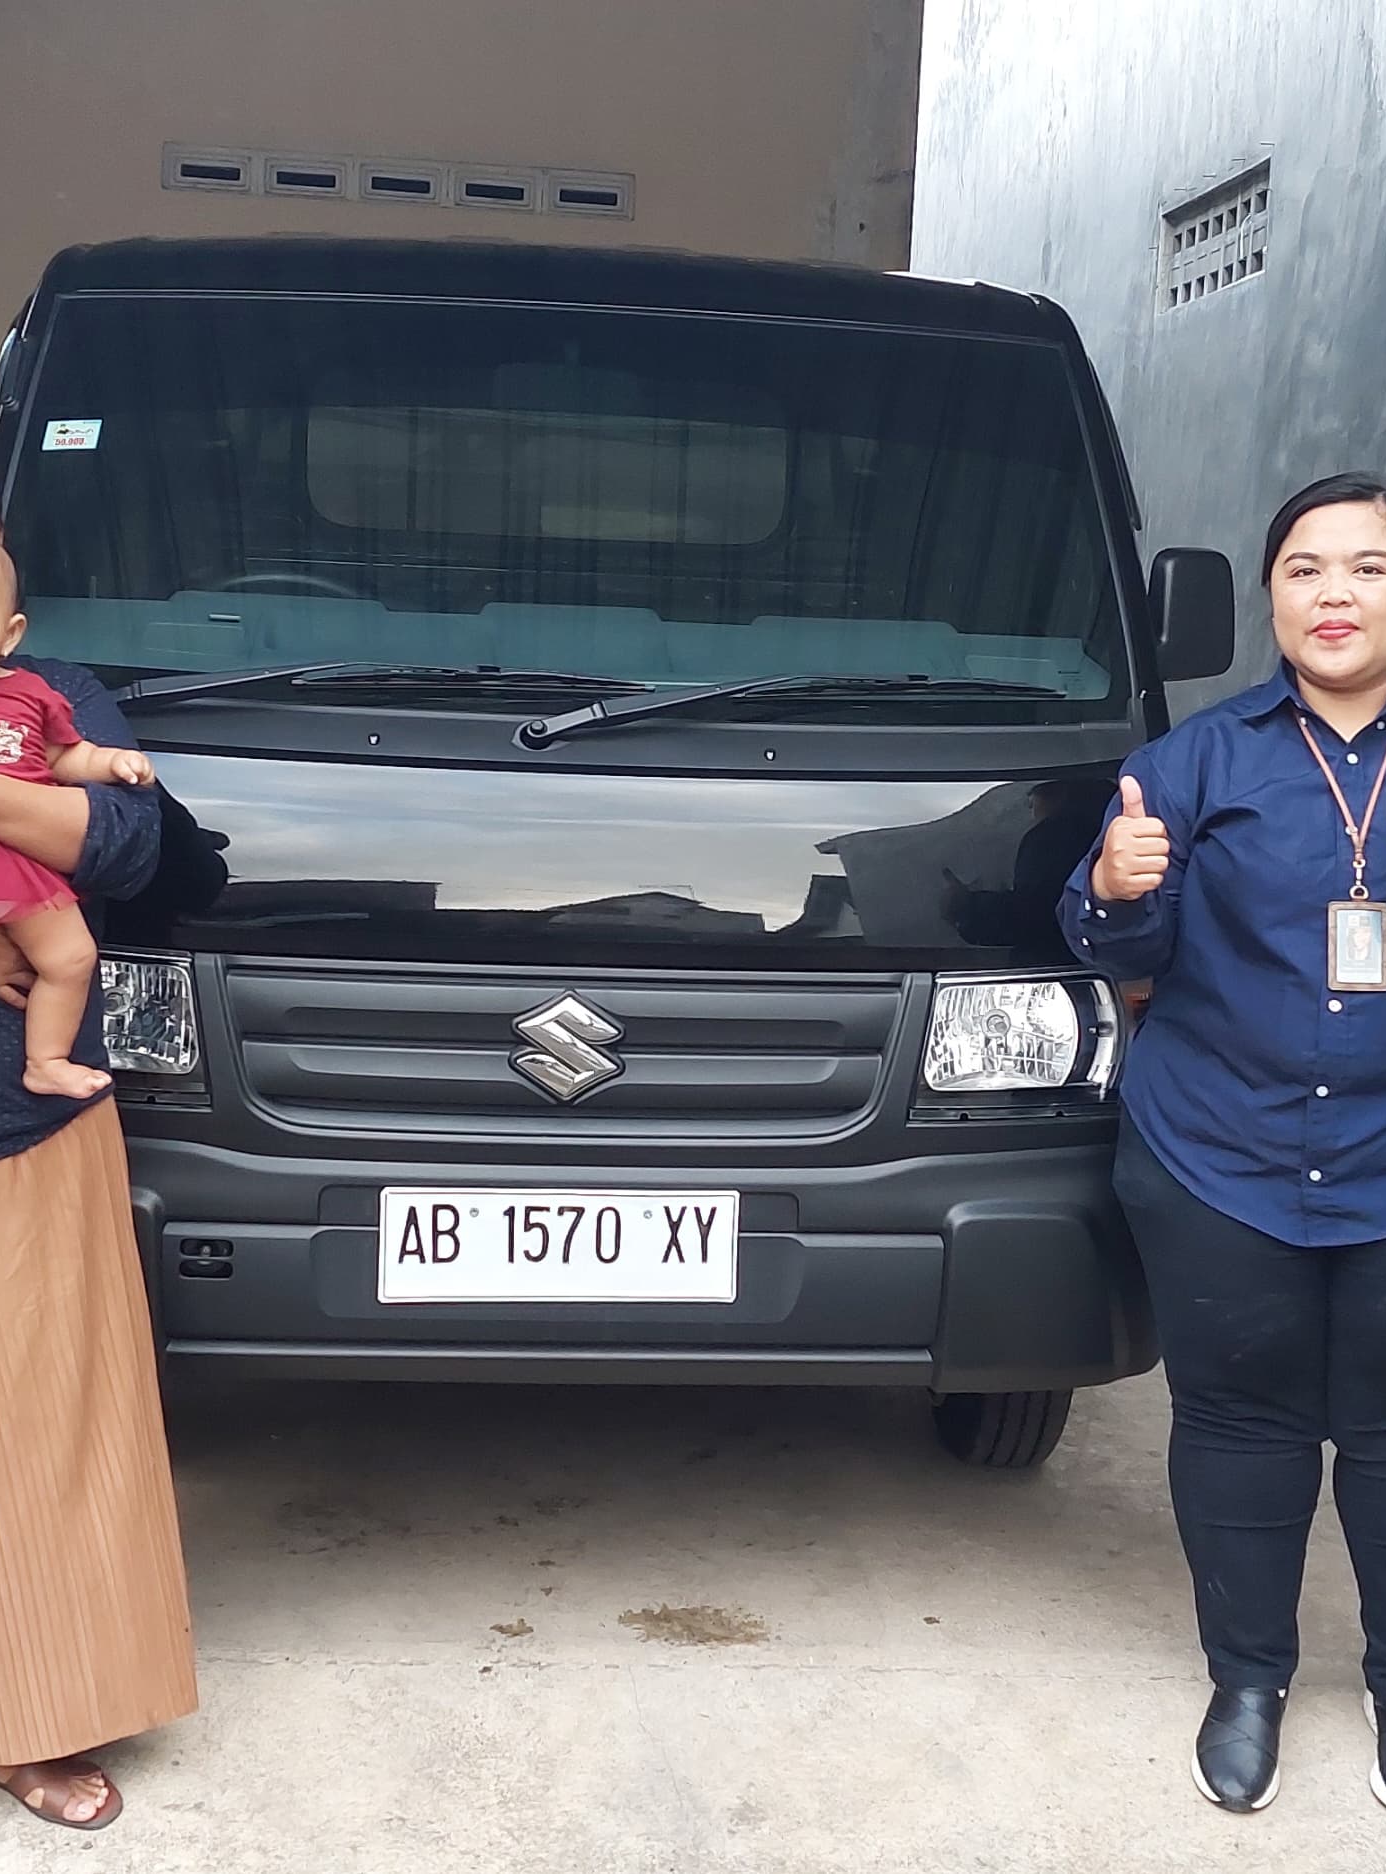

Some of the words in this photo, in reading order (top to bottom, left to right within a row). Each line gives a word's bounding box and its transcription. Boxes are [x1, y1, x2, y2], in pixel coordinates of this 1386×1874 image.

[397, 1203, 461, 1264] AB
[502, 1205, 622, 1264] 1570
[660, 1205, 718, 1264] XY
